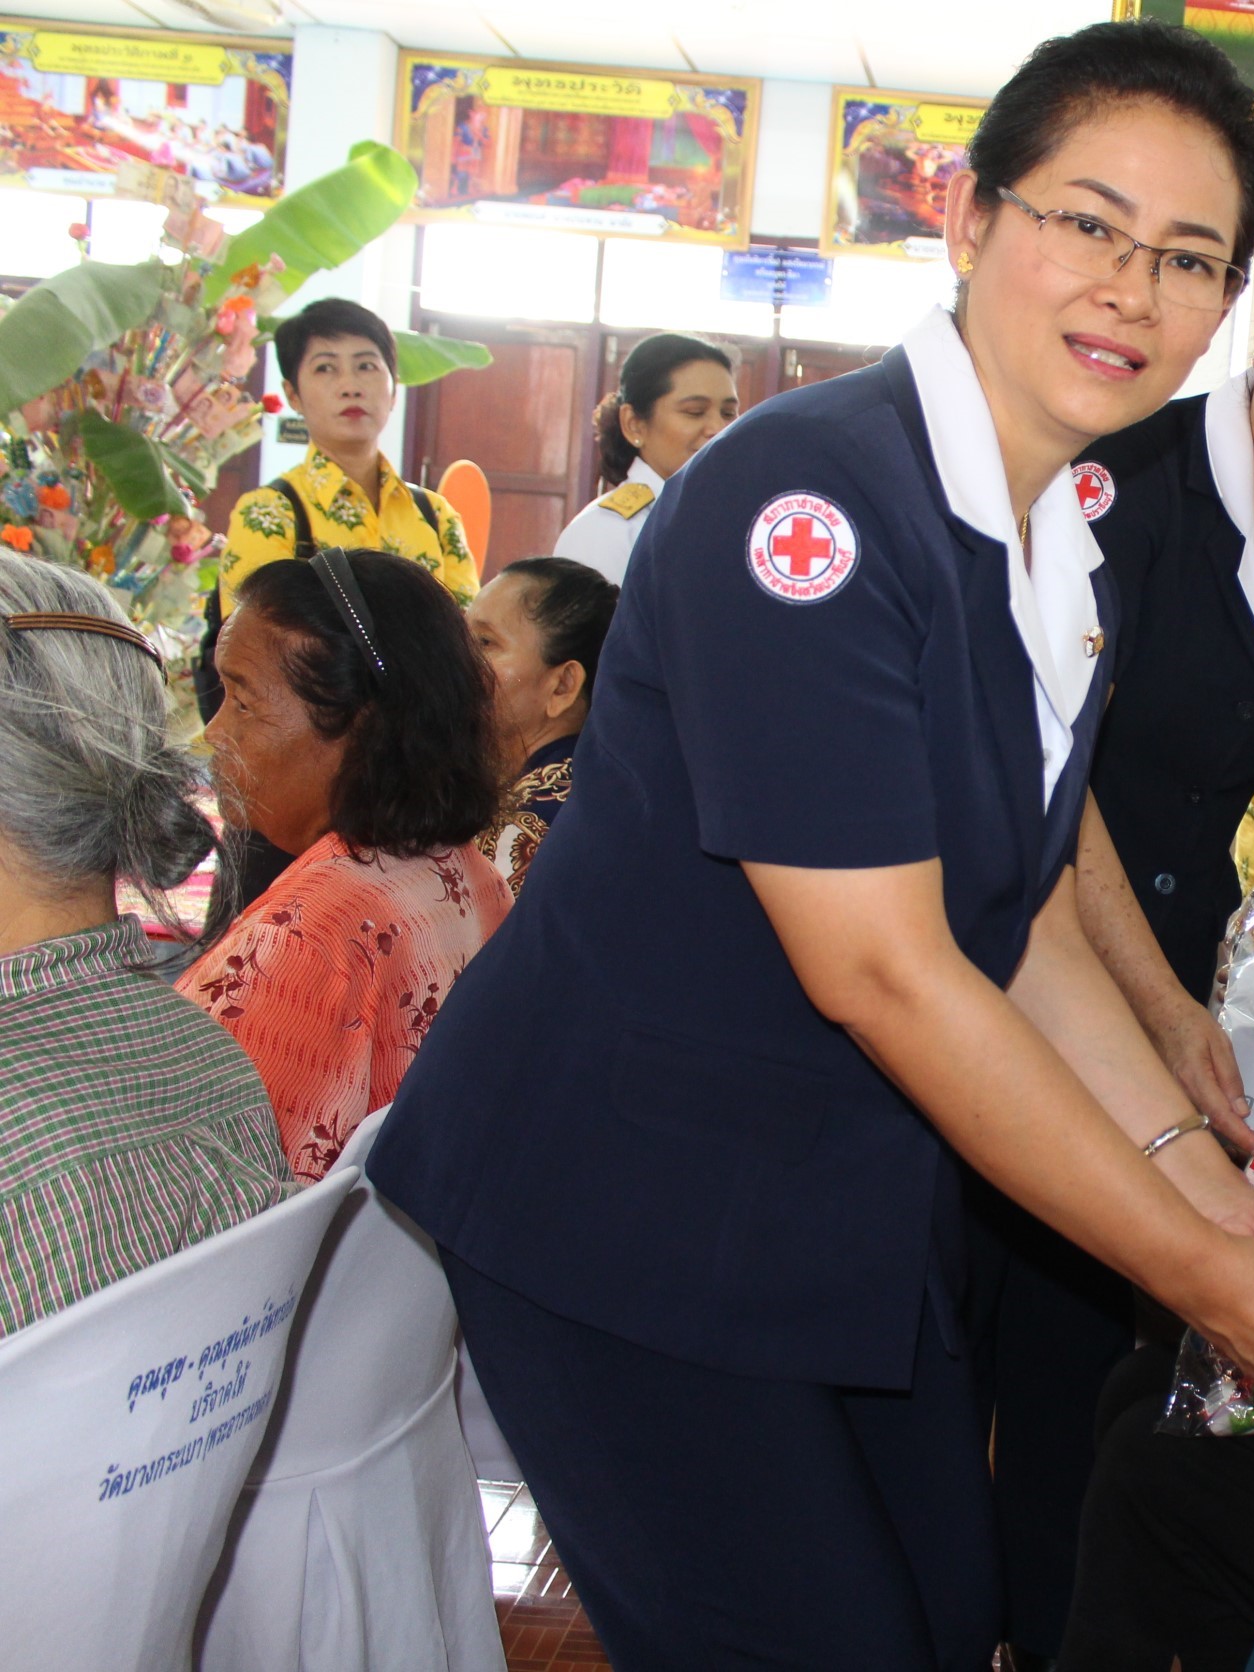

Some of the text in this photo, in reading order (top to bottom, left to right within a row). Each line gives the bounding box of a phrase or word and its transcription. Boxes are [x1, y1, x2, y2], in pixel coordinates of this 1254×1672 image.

[763, 497, 842, 527] สภากาชาดไทย
